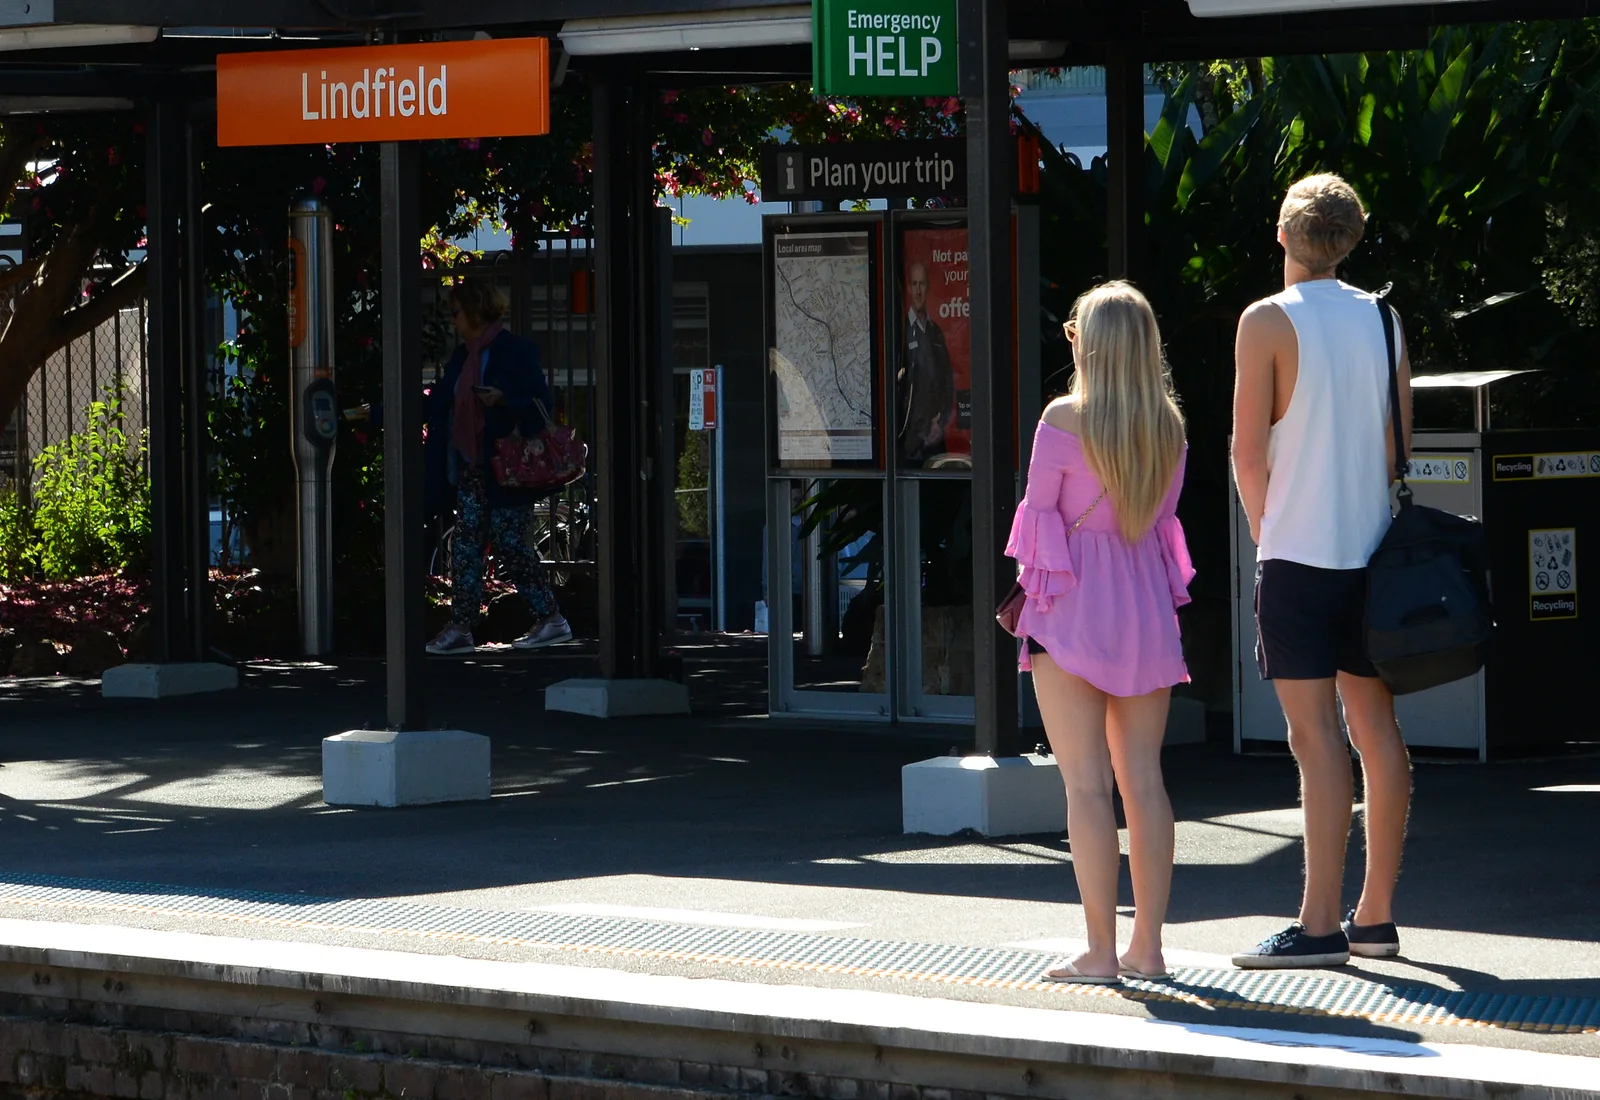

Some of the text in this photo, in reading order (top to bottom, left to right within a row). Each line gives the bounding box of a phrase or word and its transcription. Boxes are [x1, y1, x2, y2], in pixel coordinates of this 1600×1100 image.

[847, 10, 941, 33] Emergency
[848, 36, 942, 77] HELP
[301, 64, 448, 121] Lindfield
[811, 156, 856, 187] Plan
[861, 160, 913, 193] your
[915, 153, 955, 190] trip
[778, 244, 794, 253] Local
[808, 245, 822, 254] map
[932, 249, 969, 265] Not pa
[944, 270, 969, 285] your
[939, 297, 970, 318] offe
[1496, 462, 1532, 473] Recycling
[1533, 599, 1575, 611] Recycling
